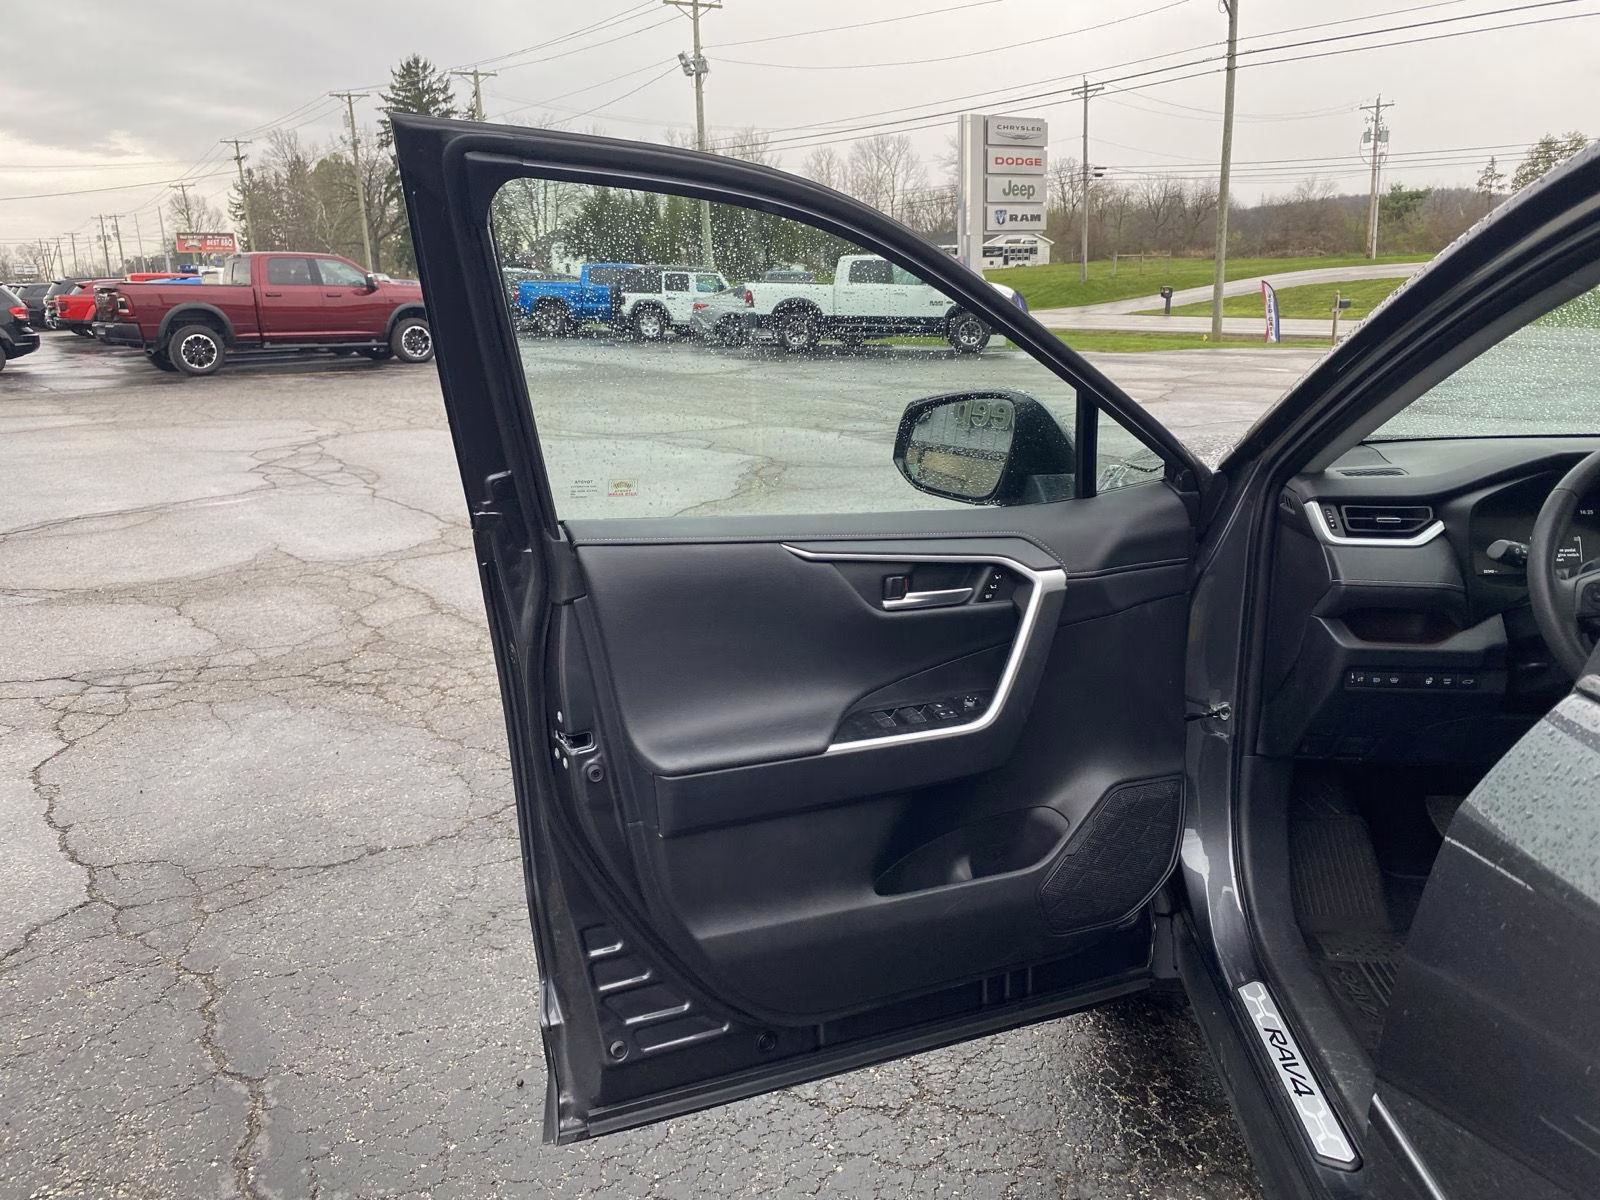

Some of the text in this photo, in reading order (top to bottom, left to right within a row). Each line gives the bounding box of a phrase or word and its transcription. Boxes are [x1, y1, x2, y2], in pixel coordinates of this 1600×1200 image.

[996, 124, 1042, 132] CHRYSLER
[994, 156, 1043, 167] DODGE
[1002, 179, 1036, 200] Jeep
[1009, 213, 1042, 222] RAM
[1263, 1027, 1315, 1097] RAV4
